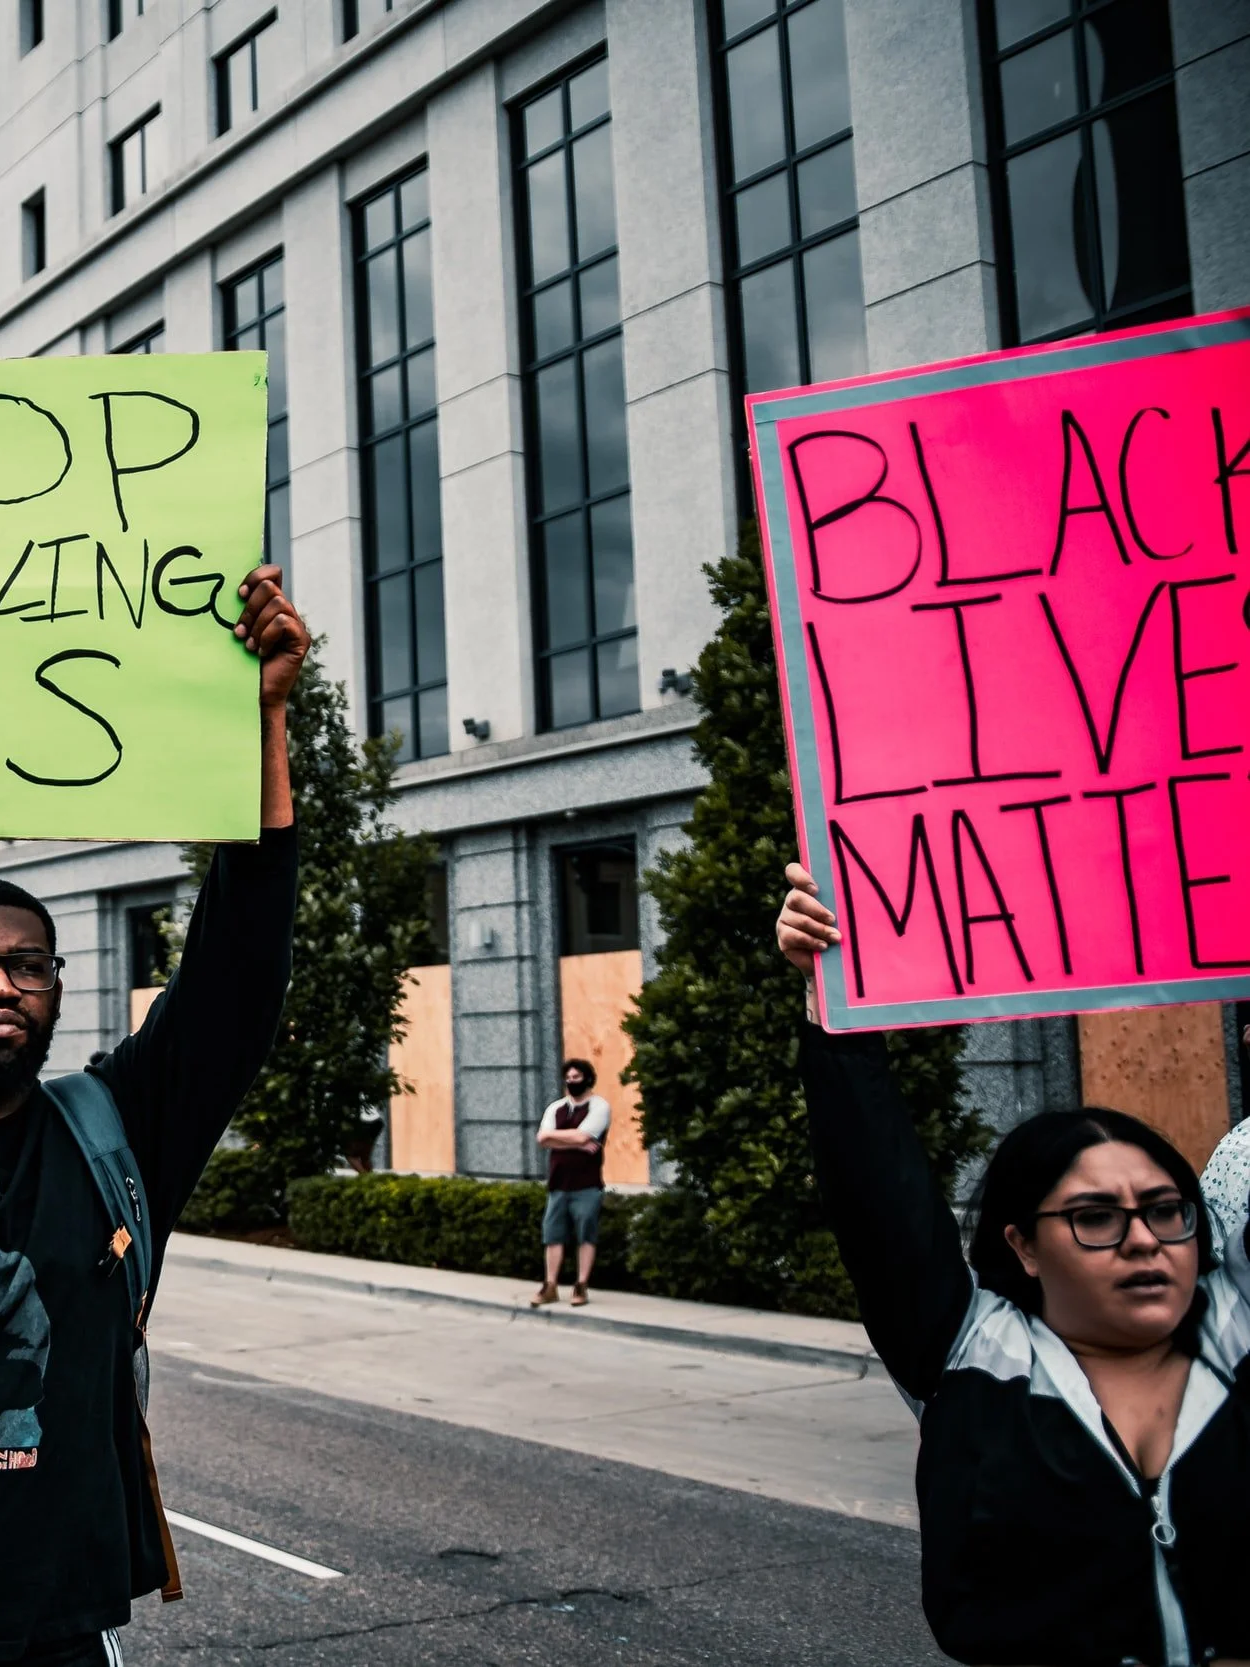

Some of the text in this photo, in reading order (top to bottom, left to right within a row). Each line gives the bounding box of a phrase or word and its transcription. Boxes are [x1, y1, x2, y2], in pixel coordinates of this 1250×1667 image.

[807, 573, 1250, 804] LIVE
[829, 772, 1250, 998] MATTE
[8, 1447, 38, 1470] HOOD
